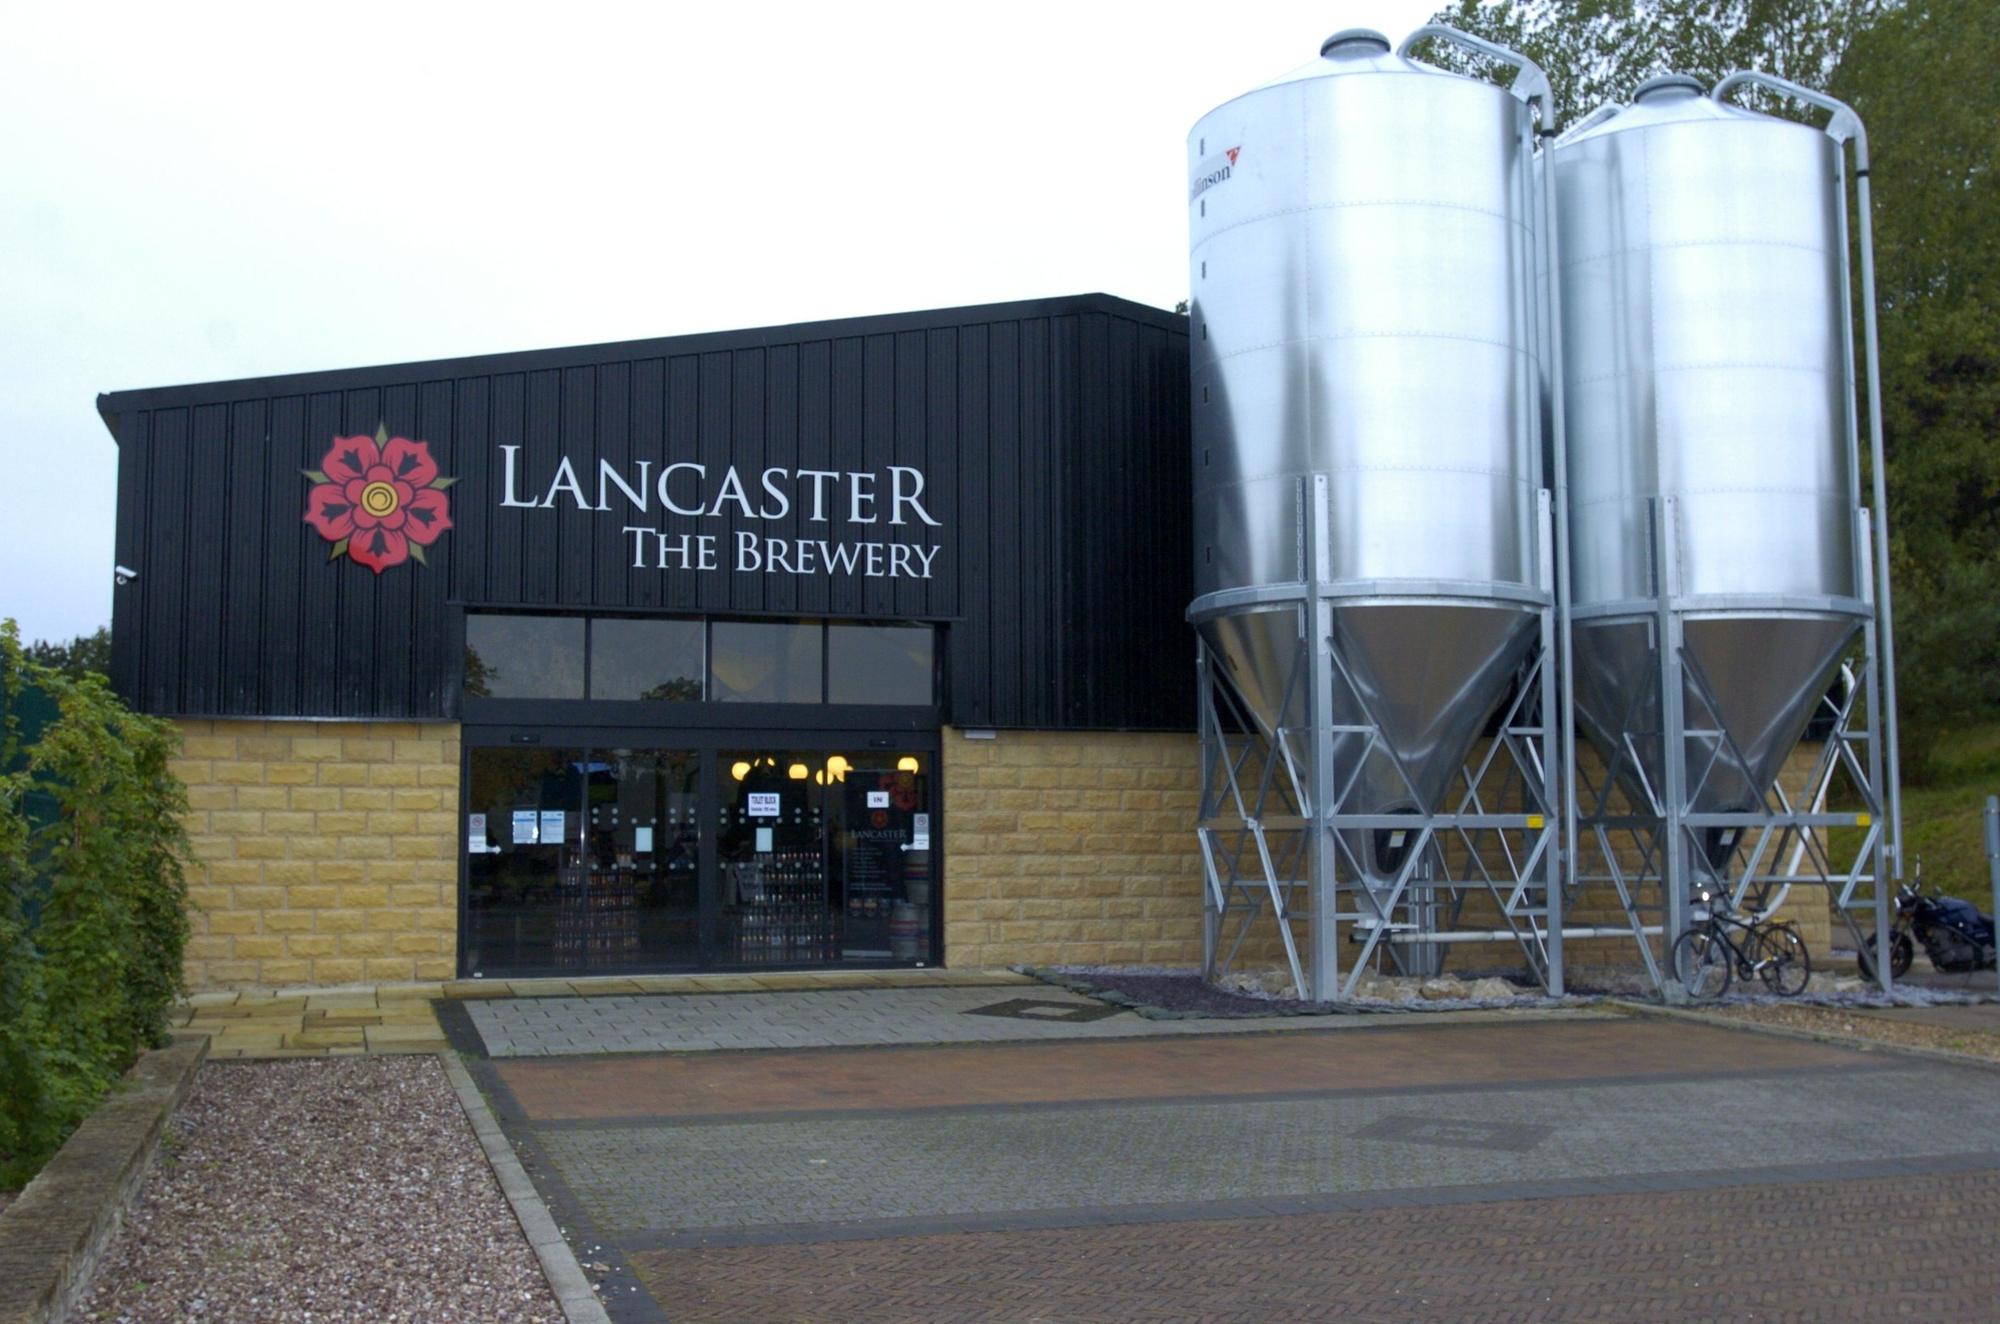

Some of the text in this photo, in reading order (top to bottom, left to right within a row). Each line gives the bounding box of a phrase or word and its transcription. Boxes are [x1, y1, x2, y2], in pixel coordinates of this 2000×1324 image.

[499, 445, 942, 525] LANCASTER
[622, 526, 940, 578] THE BREWERY
[850, 829, 907, 839] LANCASTER
